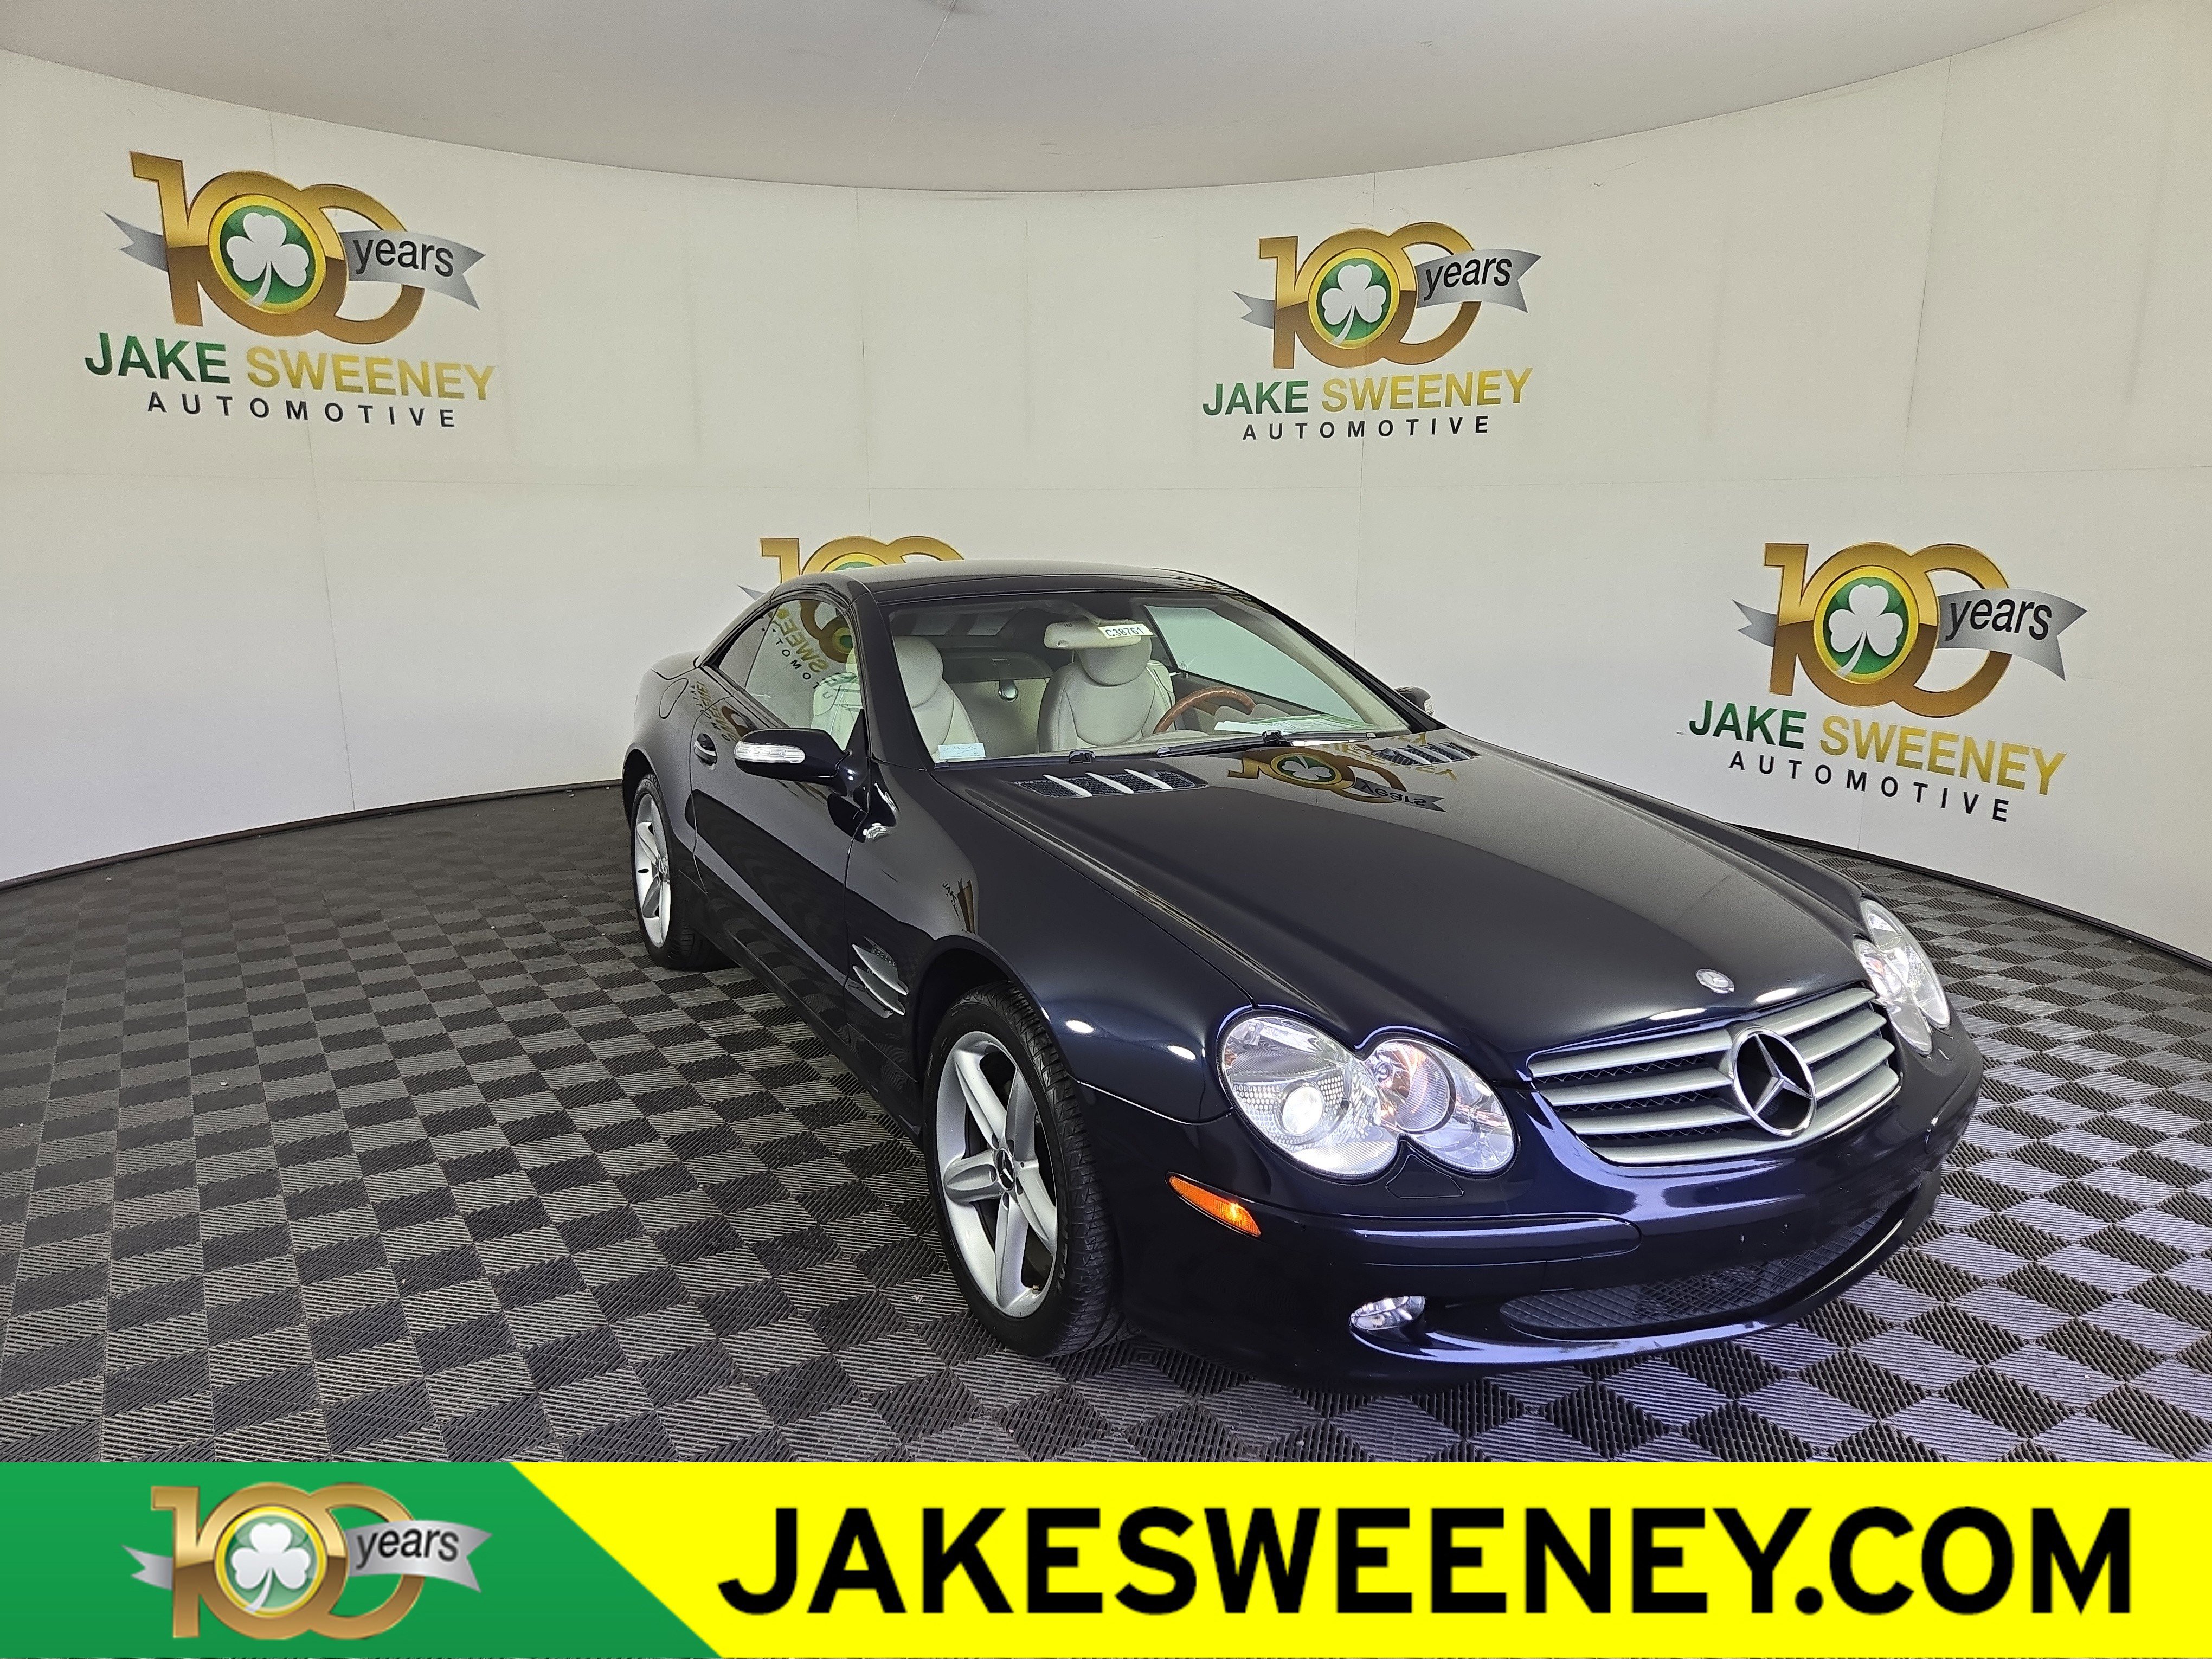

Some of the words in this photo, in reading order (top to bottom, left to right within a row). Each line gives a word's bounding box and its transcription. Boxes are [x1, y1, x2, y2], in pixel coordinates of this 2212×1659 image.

[130, 151, 425, 344] 100
[353, 234, 454, 277] years
[1259, 222, 1482, 369] 100
[1423, 256, 1512, 301] years
[85, 331, 231, 384] JAKE
[246, 346, 496, 401] SWEENEY
[1203, 380, 1309, 416] JAKE
[1321, 368, 1534, 413] SWEENEY
[147, 391, 455, 428] AUTOMOTIVE
[1242, 415, 1489, 441] AUTOMOTIVE
[1105, 627, 1144, 637] C38761
[1764, 541, 2012, 718] 100
[1944, 598, 2053, 641] years
[1688, 700, 1808, 750] JAKE
[1820, 715, 2067, 796] SWEENEY
[1729, 751, 2009, 822] AUTOMOTIVE
